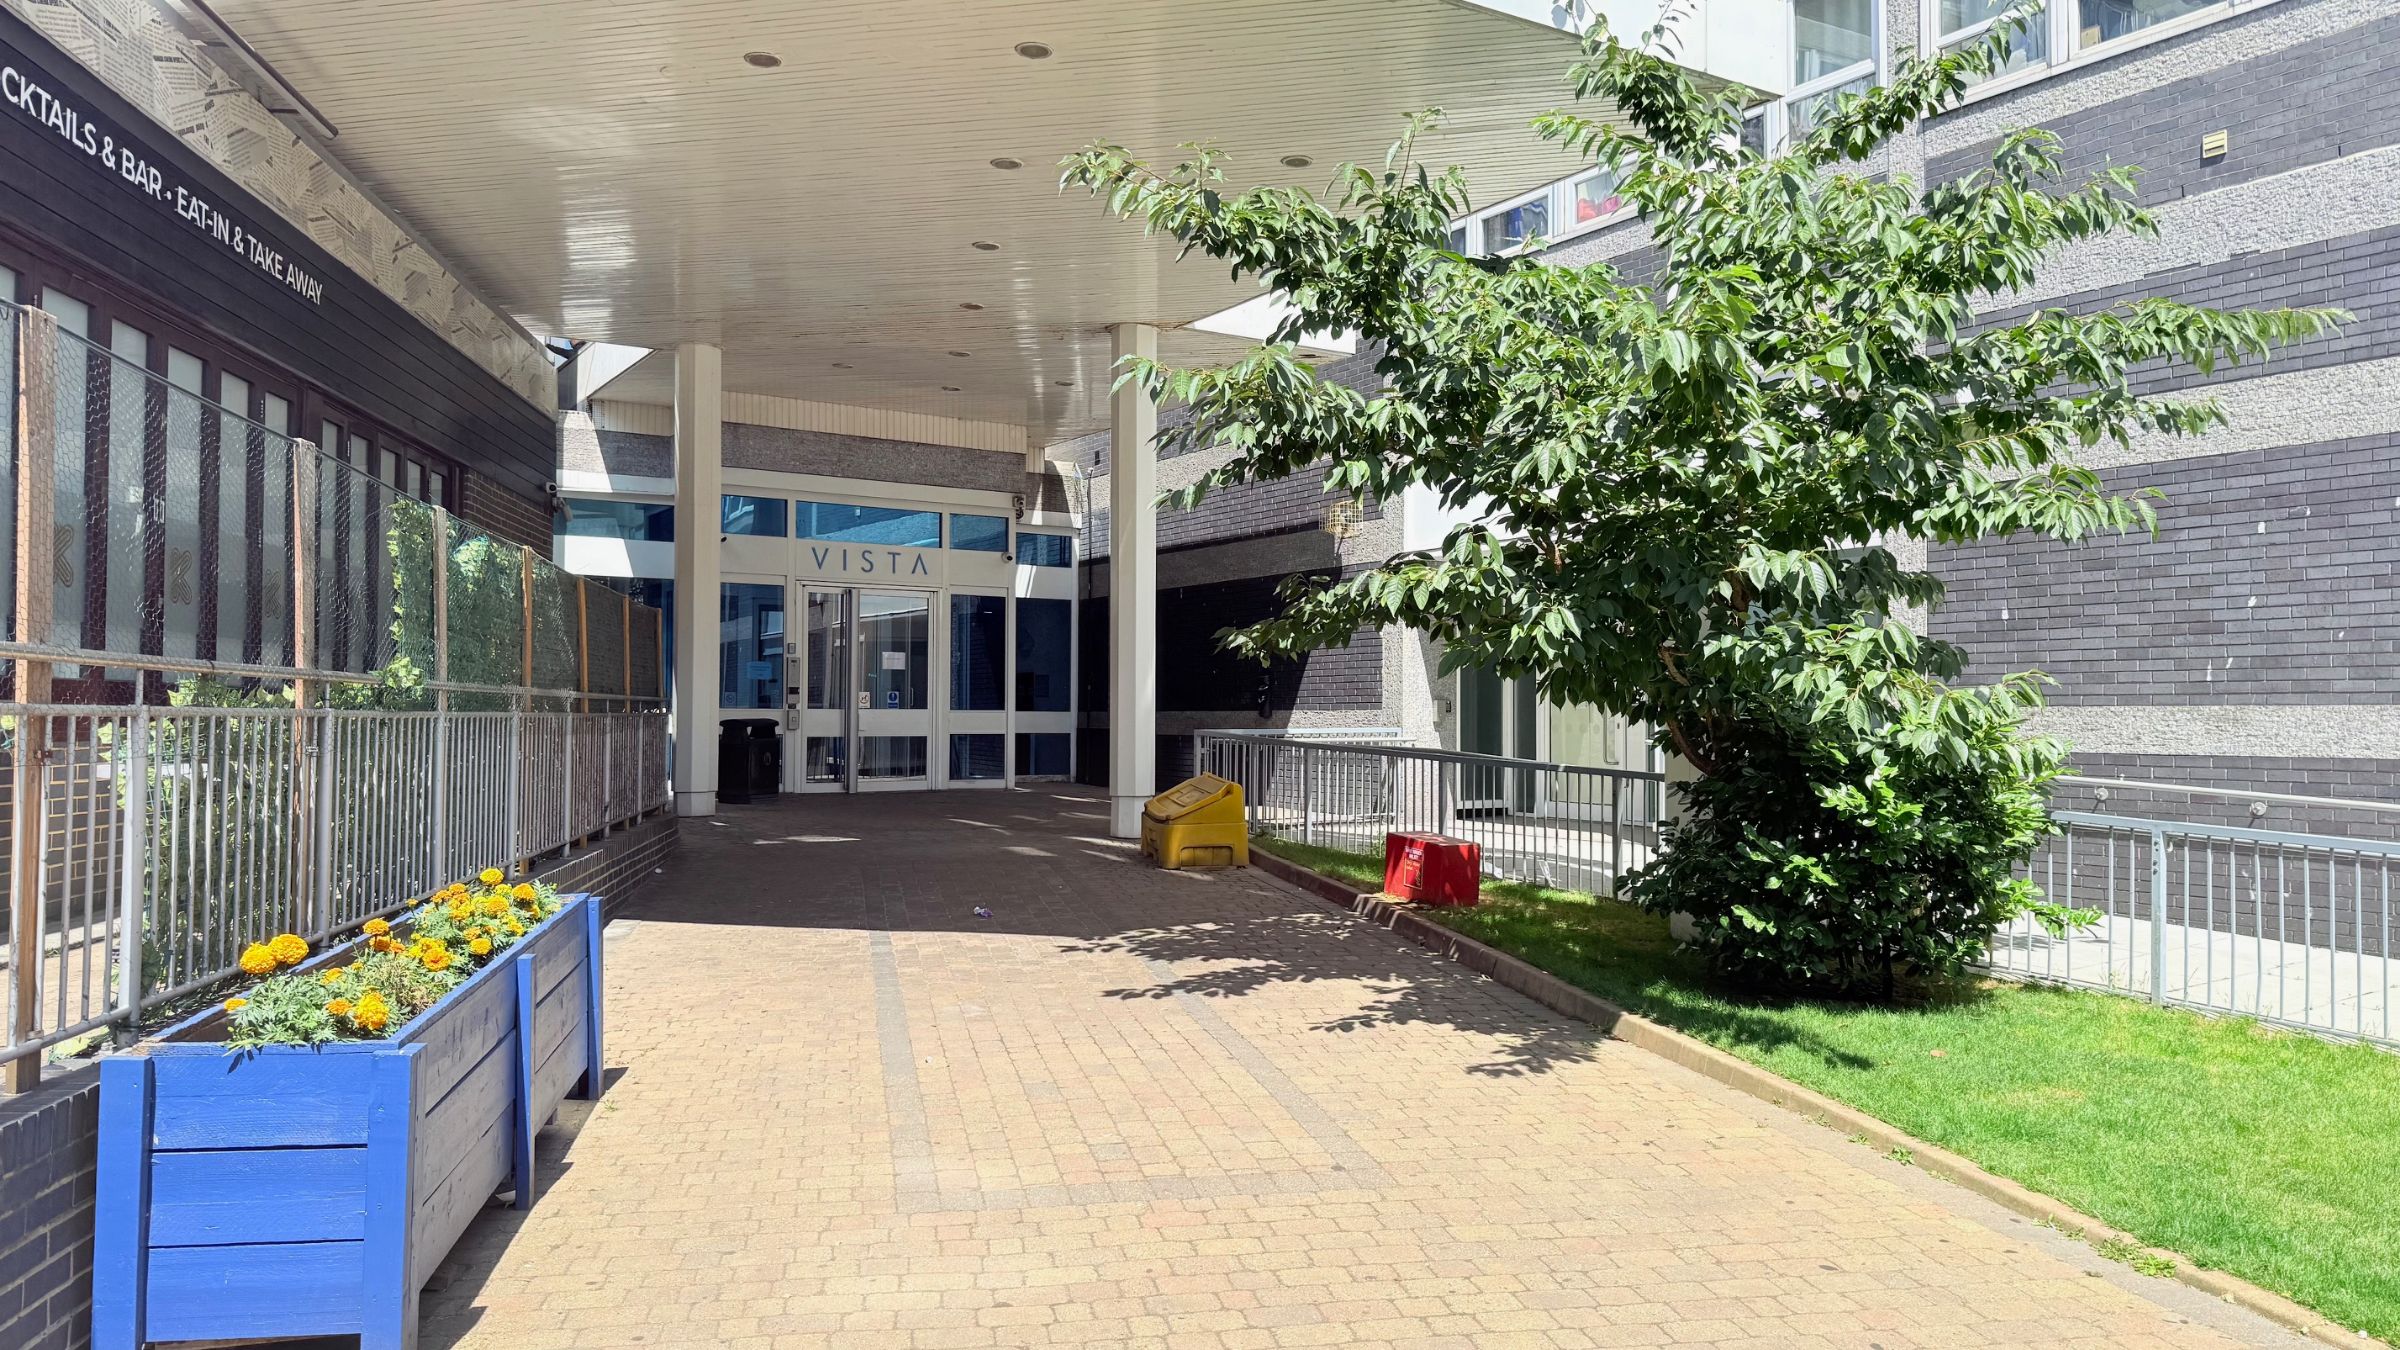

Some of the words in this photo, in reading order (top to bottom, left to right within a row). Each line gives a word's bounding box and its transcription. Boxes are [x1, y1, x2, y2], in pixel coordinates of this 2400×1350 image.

[102, 135, 116, 171] &
[122, 147, 162, 201] BAR
[177, 185, 229, 246] EAT-IN
[233, 226, 244, 255] &
[247, 233, 284, 281] TAKE
[286, 263, 323, 306] AWAY
[811, 546, 928, 576] VISTA
